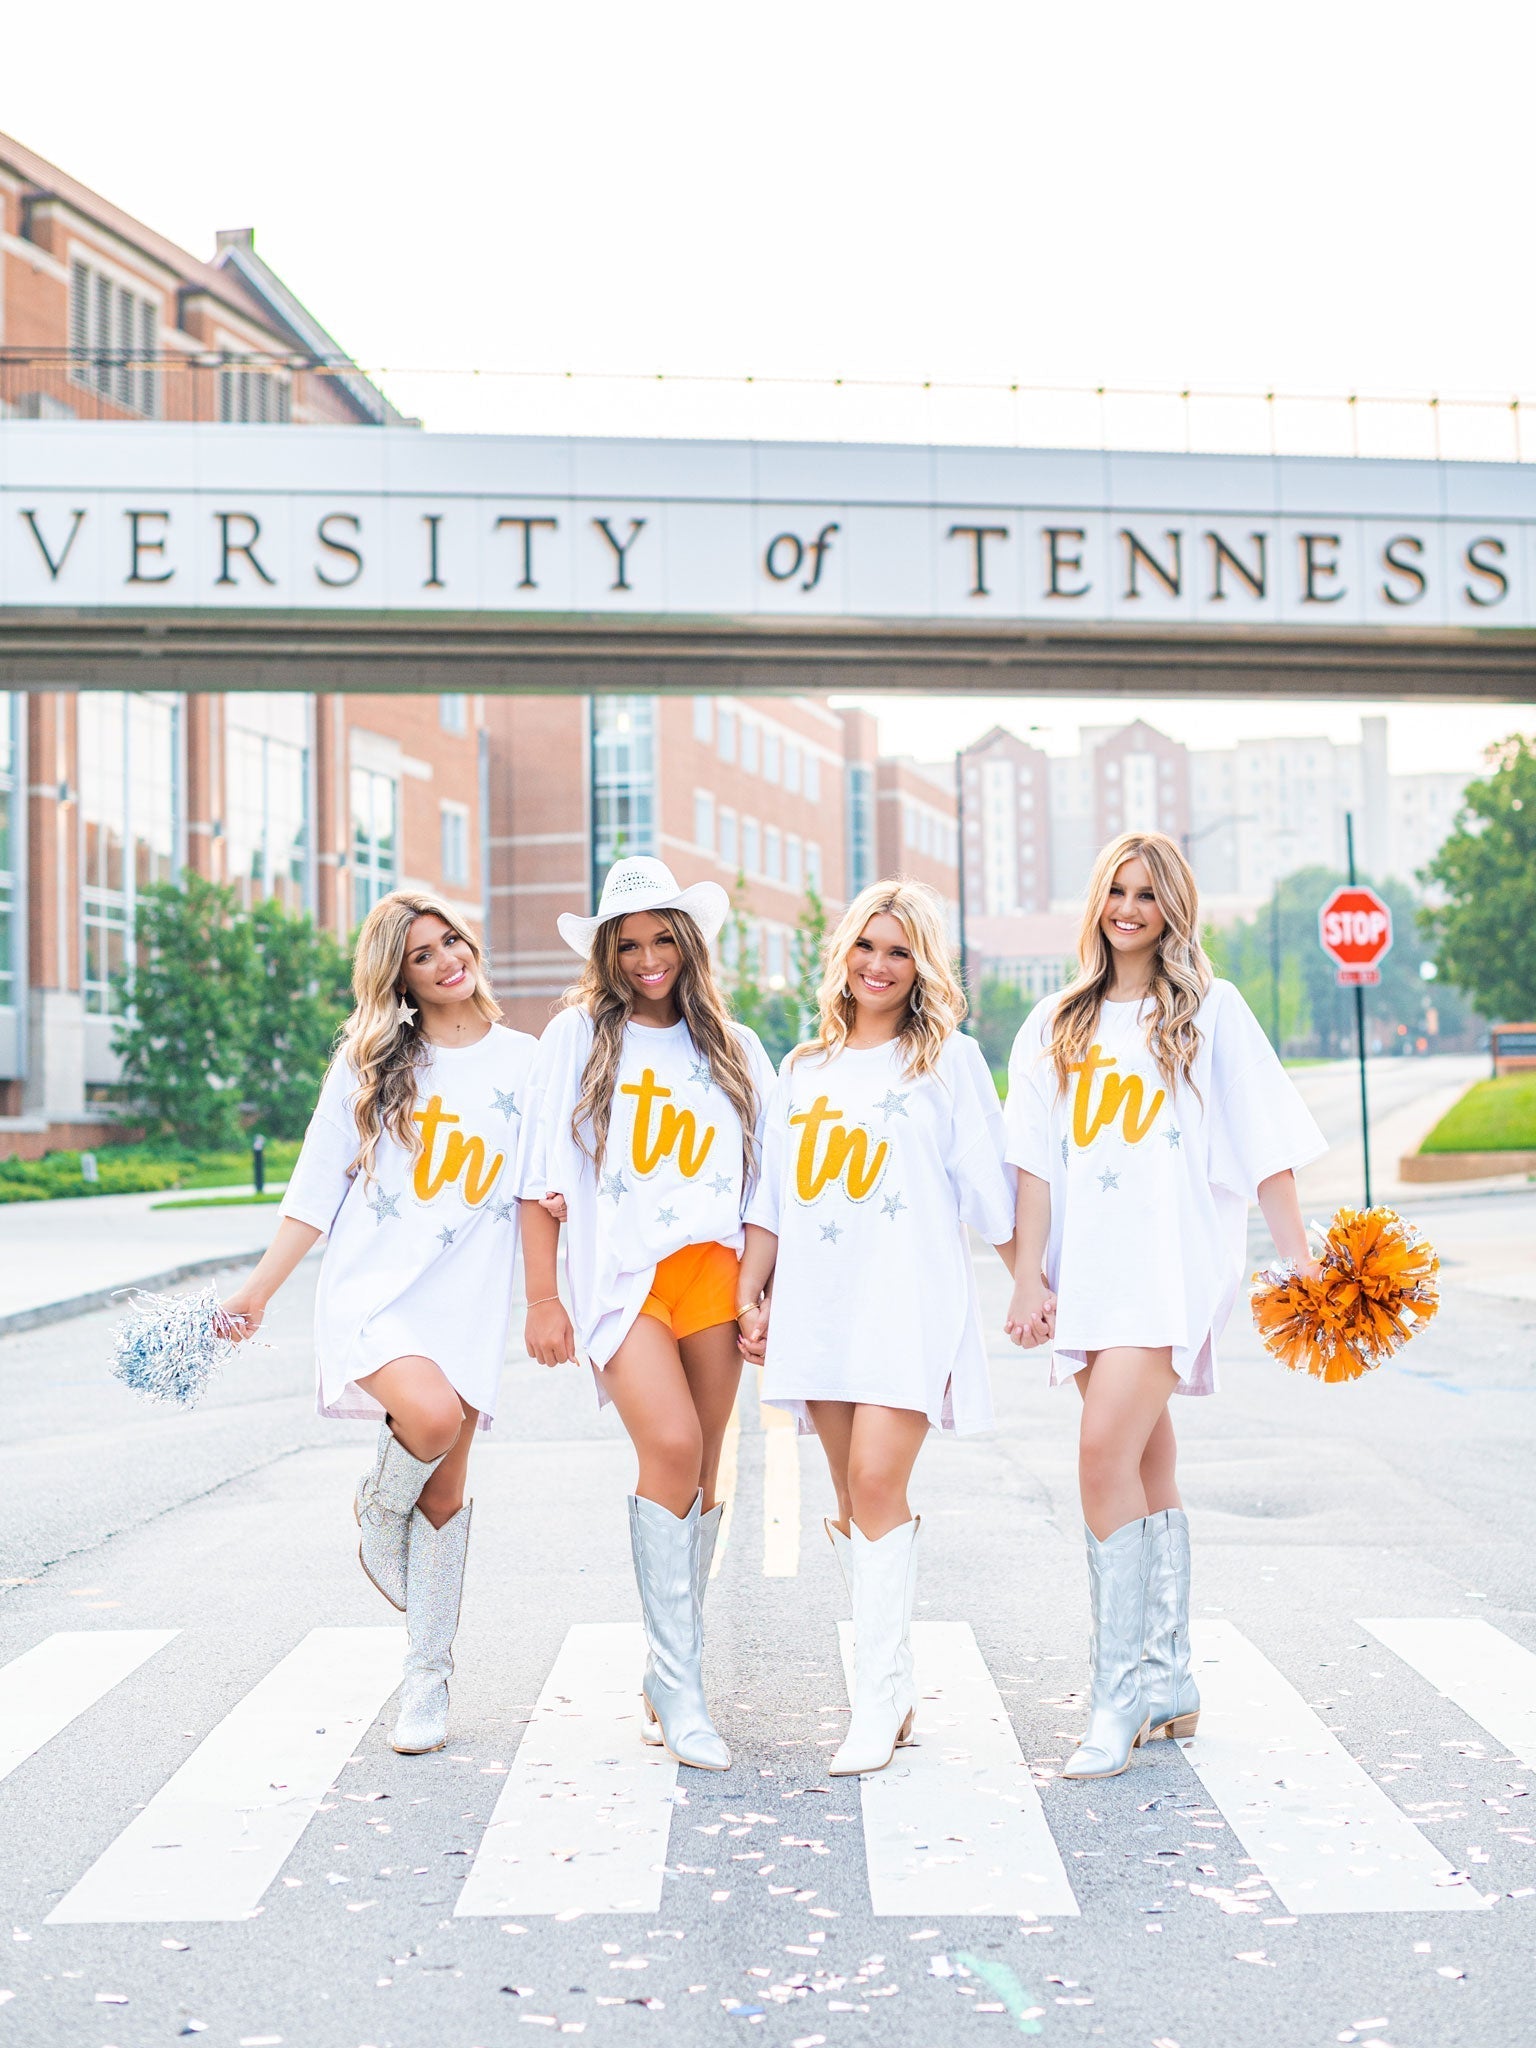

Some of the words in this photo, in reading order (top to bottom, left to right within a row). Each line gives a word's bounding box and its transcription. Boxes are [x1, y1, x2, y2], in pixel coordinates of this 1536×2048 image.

[18, 508, 647, 592] VERSITY
[762, 521, 842, 593] of
[945, 523, 1511, 608] TENNESS
[1325, 911, 1387, 945] STOP
[620, 1068, 716, 1178] tn
[789, 1095, 889, 1201] tn
[1064, 1044, 1166, 1148] tn
[411, 1095, 505, 1205] tn
